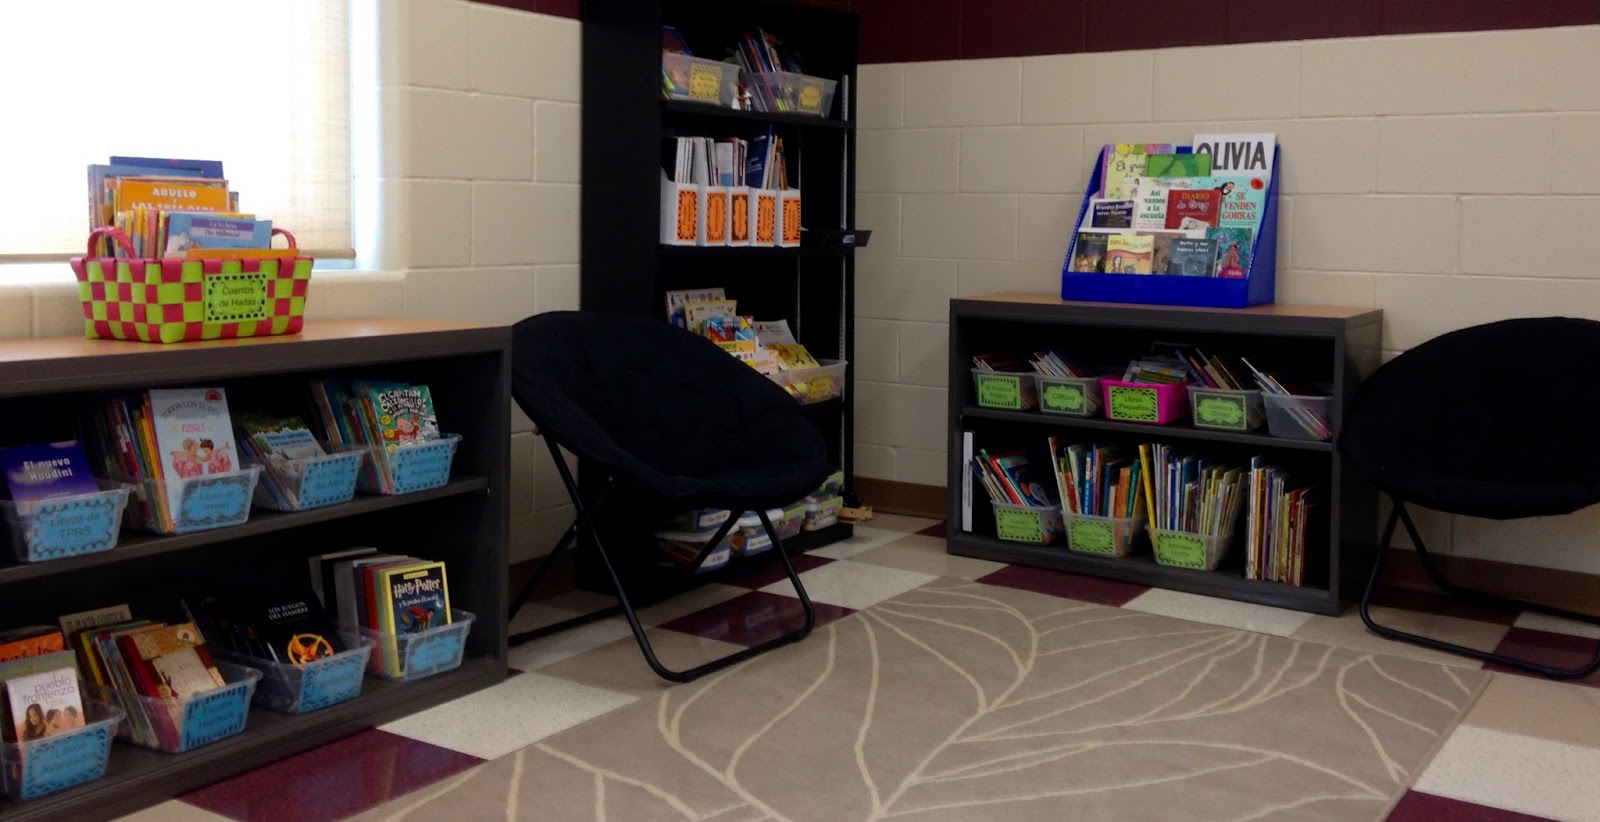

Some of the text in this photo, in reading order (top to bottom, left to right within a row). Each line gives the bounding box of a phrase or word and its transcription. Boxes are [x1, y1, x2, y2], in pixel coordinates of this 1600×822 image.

[152, 187, 198, 199] ABUELO
[1181, 192, 1210, 200] DIARIO
[1236, 192, 1246, 200] SE
[1223, 201, 1257, 210] VENDEN
[1222, 211, 1257, 220] GORRAS
[221, 286, 255, 296] Cuentos
[218, 298, 257, 308] de Hadas
[1123, 395, 1143, 403] Libros
[23, 457, 71, 471] El nuevo
[29, 467, 73, 481] Houdini
[50, 511, 101, 527] Libros de
[393, 577, 441, 599] Harry Potter
[267, 601, 306, 614] LOS JUEGOS
[268, 612, 282, 620] DEL
[34, 675, 72, 695] pueblo
